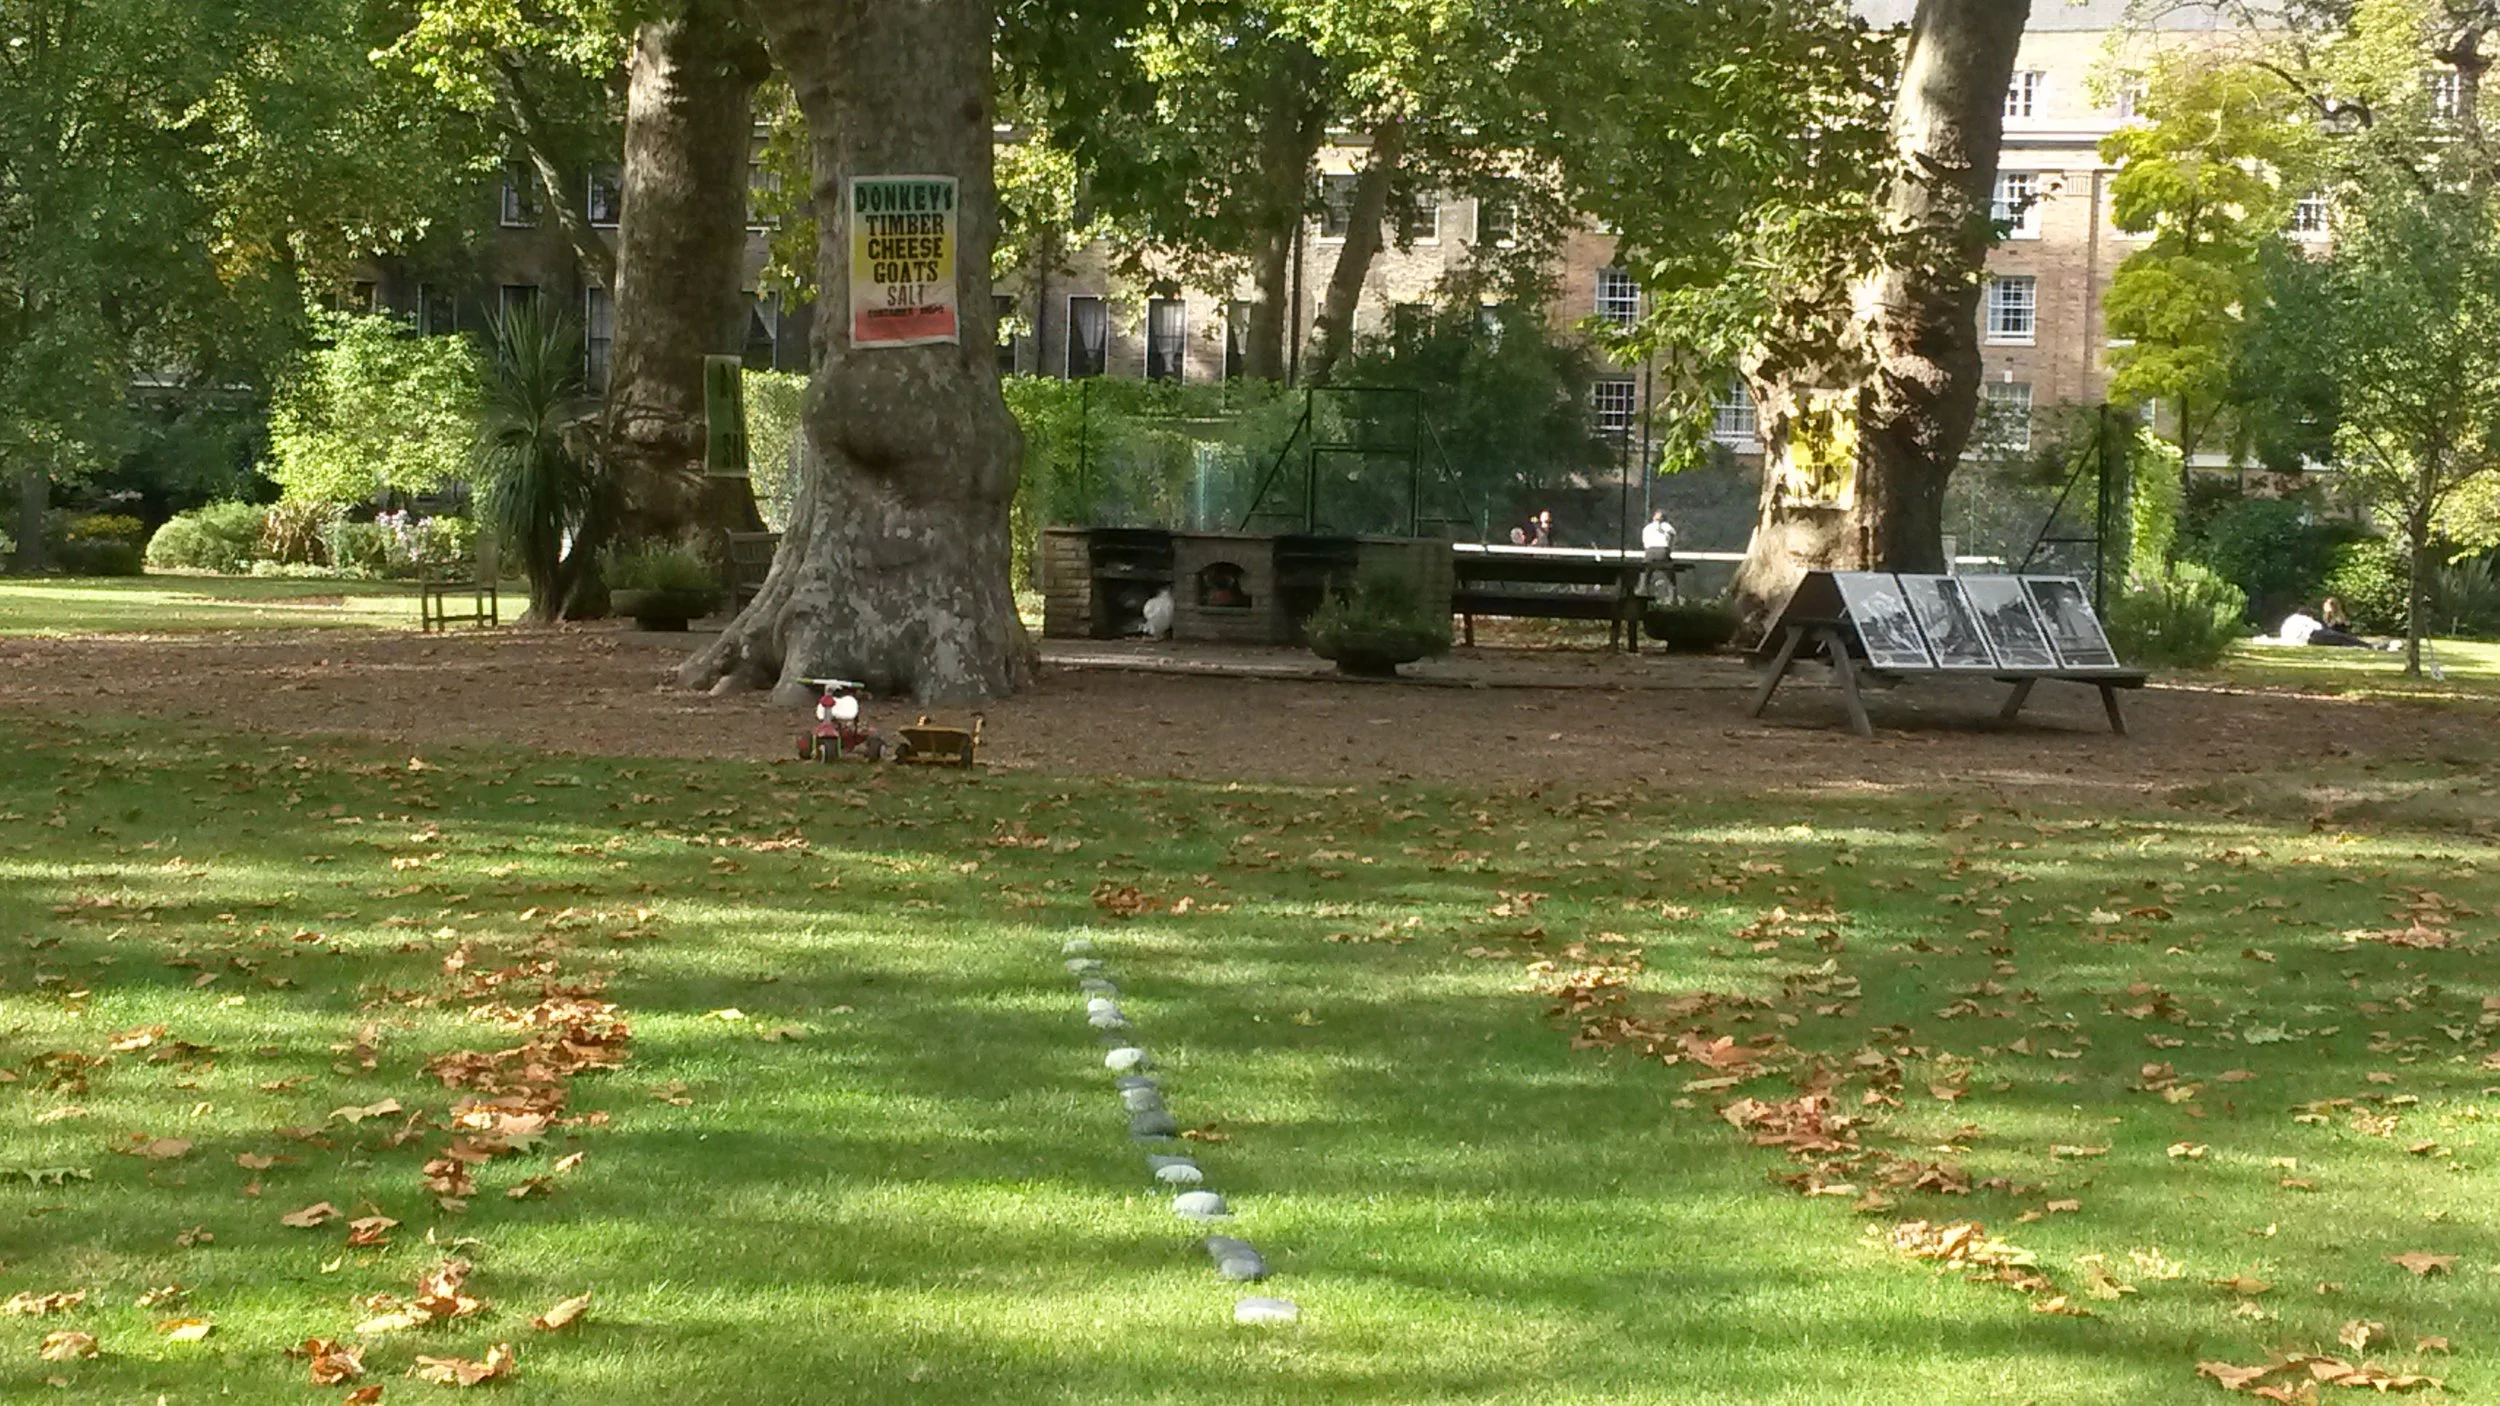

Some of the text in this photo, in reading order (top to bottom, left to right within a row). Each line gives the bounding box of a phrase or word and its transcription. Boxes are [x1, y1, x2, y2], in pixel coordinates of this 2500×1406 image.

[866, 213, 944, 236] TIMBER
[868, 237, 943, 260] CHEESE
[874, 261, 938, 283] GOATS
[887, 284, 925, 306] SALT
